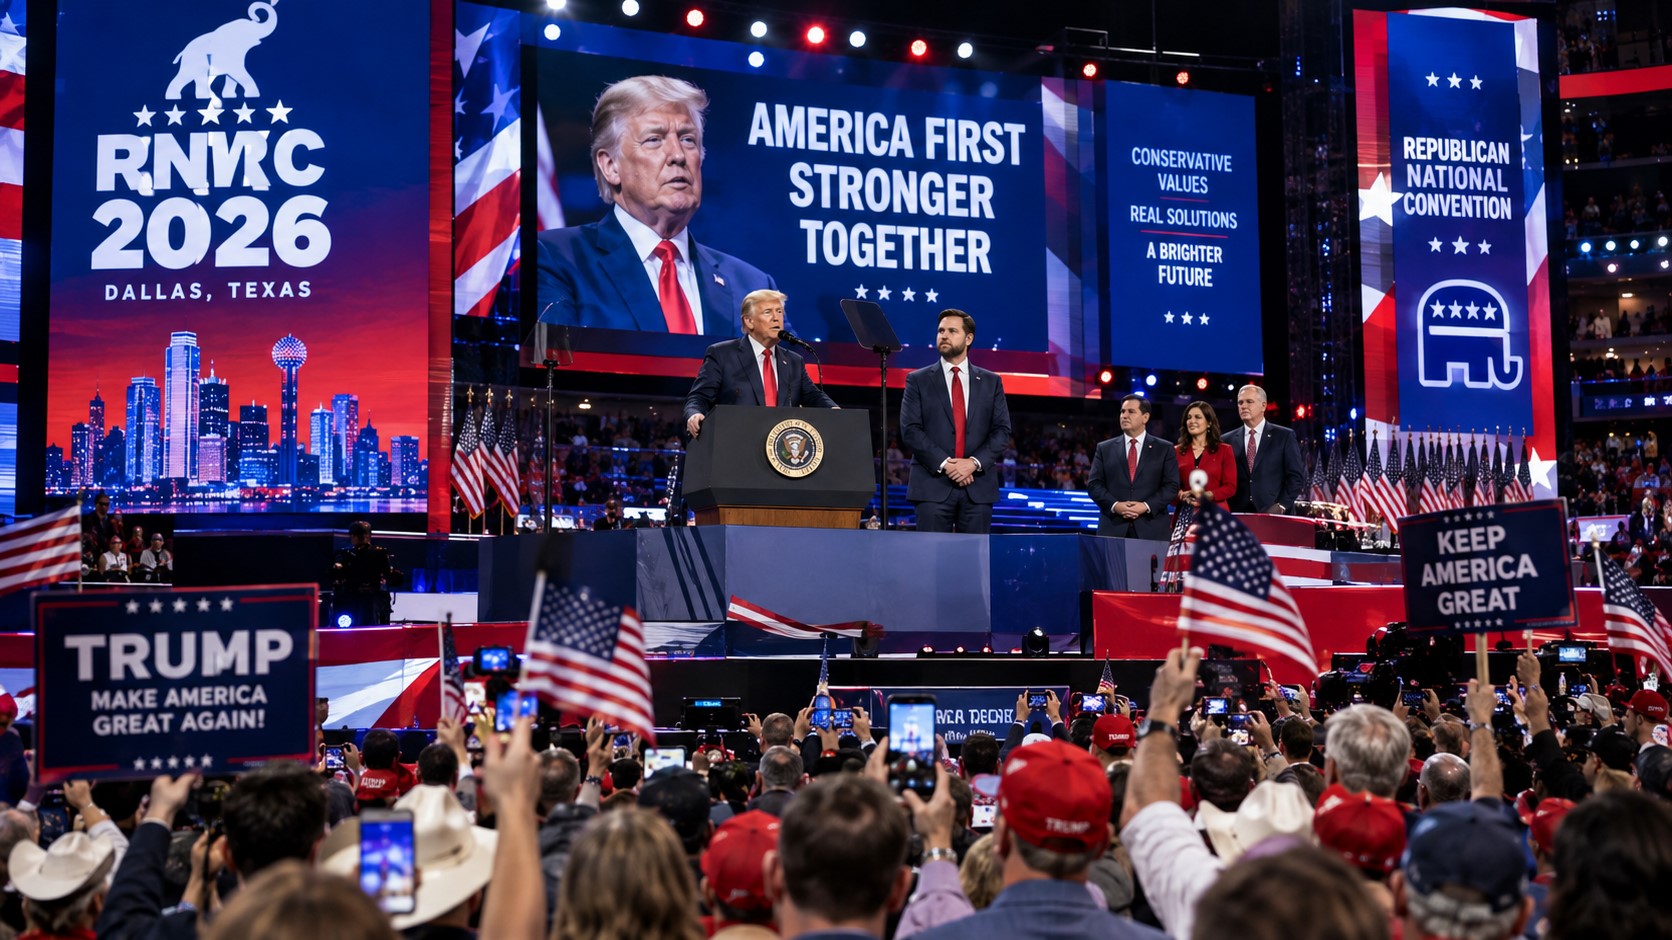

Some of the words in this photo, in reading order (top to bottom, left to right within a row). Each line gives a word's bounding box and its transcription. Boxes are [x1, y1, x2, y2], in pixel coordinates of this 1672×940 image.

[748, 102, 914, 158] AMERICA
[926, 117, 1025, 165] FIRST
[1131, 147, 1232, 172] CONSERVATIVE
[1403, 136, 1510, 164] REPUBLICAN
[789, 162, 995, 219] STRONGER
[1158, 173, 1208, 193] VALUES
[1406, 164, 1508, 192] NATIONAL
[1131, 205, 1163, 224] REAL
[1167, 208, 1237, 229] SOLUTIONS
[1403, 192, 1512, 220] CONVENTION
[91, 195, 332, 270] 2026
[800, 219, 992, 274] TOGETHER
[1147, 242, 1156, 258] A
[1159, 242, 1223, 263] BRIGHTER
[1159, 265, 1212, 287] FUTURE
[105, 283, 211, 301] DALLAS,
[228, 281, 310, 298] TEXAS
[1436, 525, 1506, 555] KEEP
[1421, 553, 1538, 587] AMERICA
[1437, 586, 1520, 615] GREAT
[65, 629, 293, 680] TRUMP
[92, 689, 157, 710] MAKE
[164, 685, 267, 707] AMERICA
[93, 713, 174, 735] GREAT
[181, 709, 264, 731] AGAIN!
